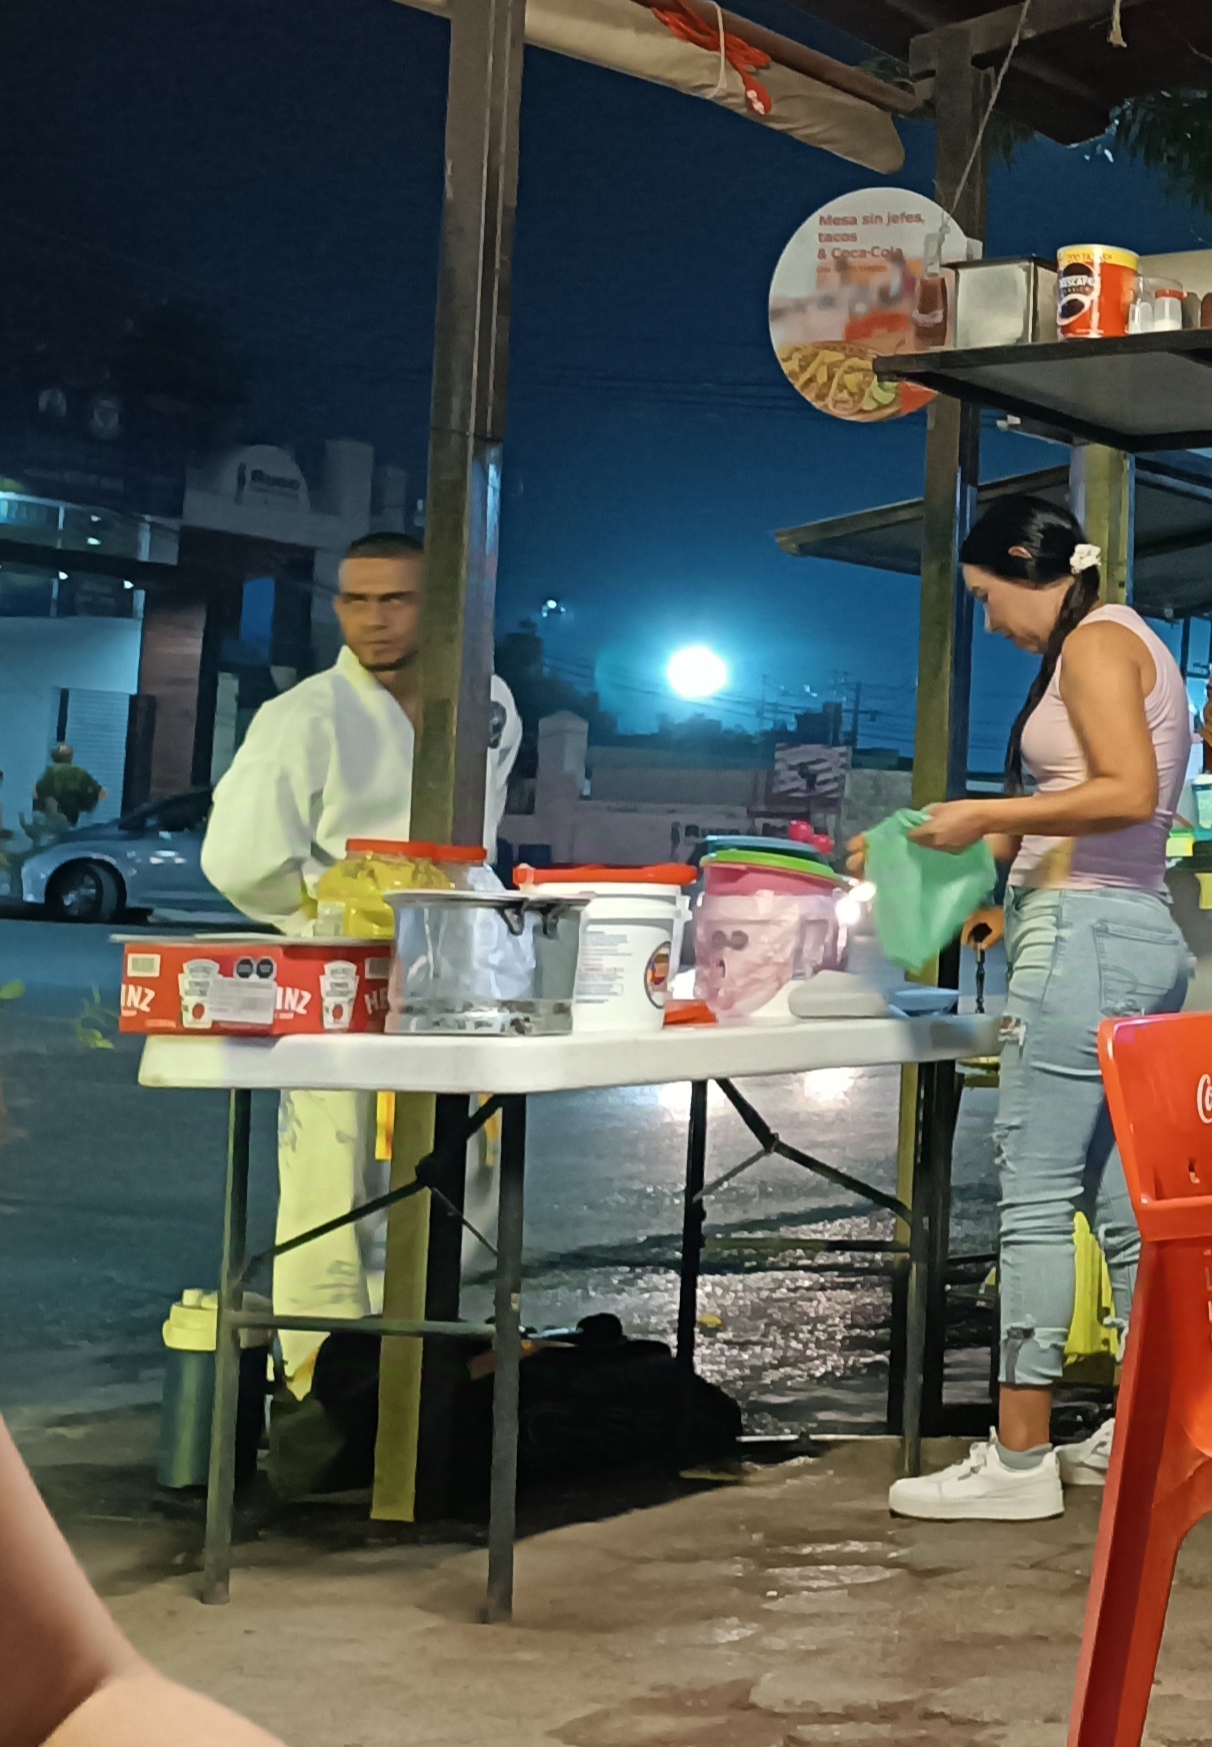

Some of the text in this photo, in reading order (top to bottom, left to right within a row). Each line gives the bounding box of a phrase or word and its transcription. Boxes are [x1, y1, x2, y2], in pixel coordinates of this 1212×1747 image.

[819, 211, 925, 226] Mesa sin jefes,
[818, 232, 858, 243] tacos
[830, 246, 904, 260] Coca-Cola
[120, 984, 156, 1013] INZ
[276, 986, 312, 1015] INZ
